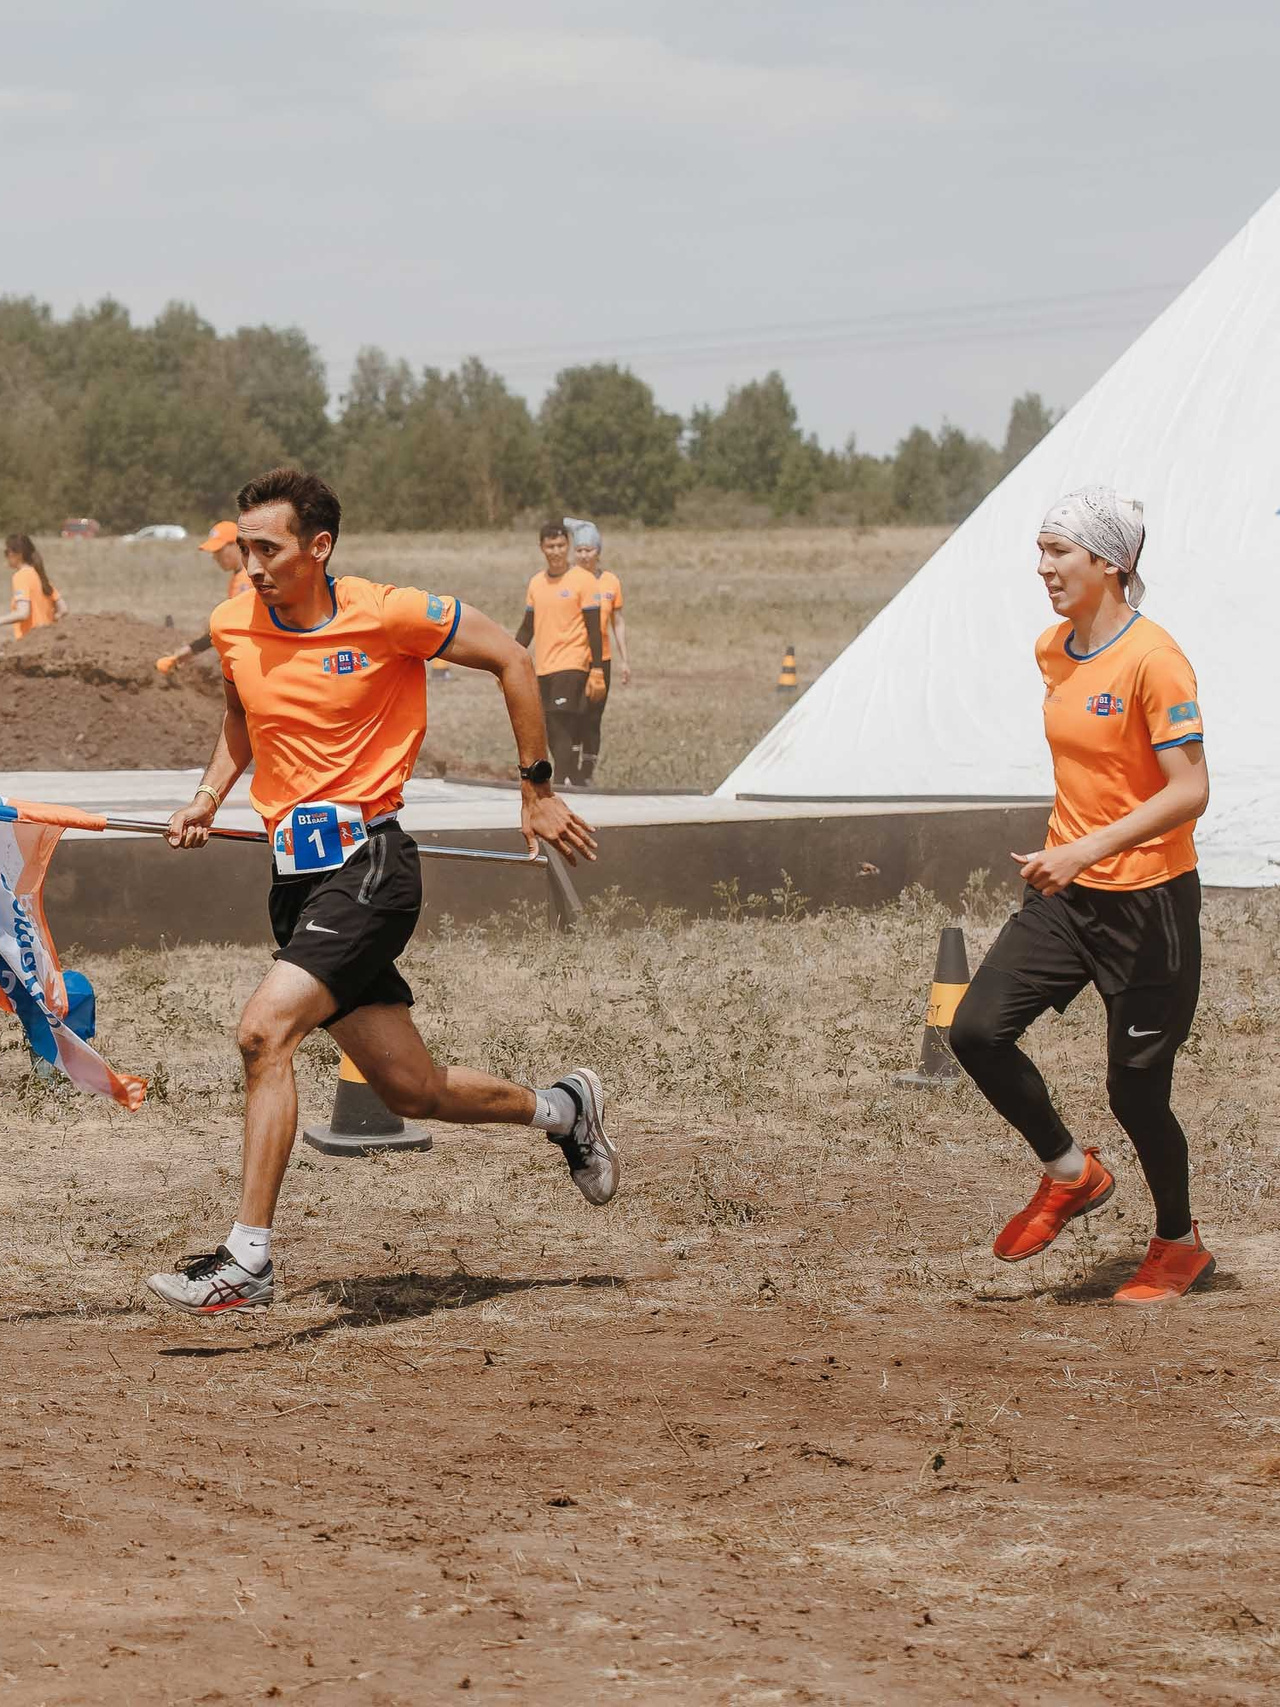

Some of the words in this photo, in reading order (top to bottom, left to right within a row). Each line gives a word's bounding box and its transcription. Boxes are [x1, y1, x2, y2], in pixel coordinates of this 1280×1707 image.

[339, 654, 349, 662] BI
[298, 814, 311, 825] BI
[308, 829, 326, 858] 1
